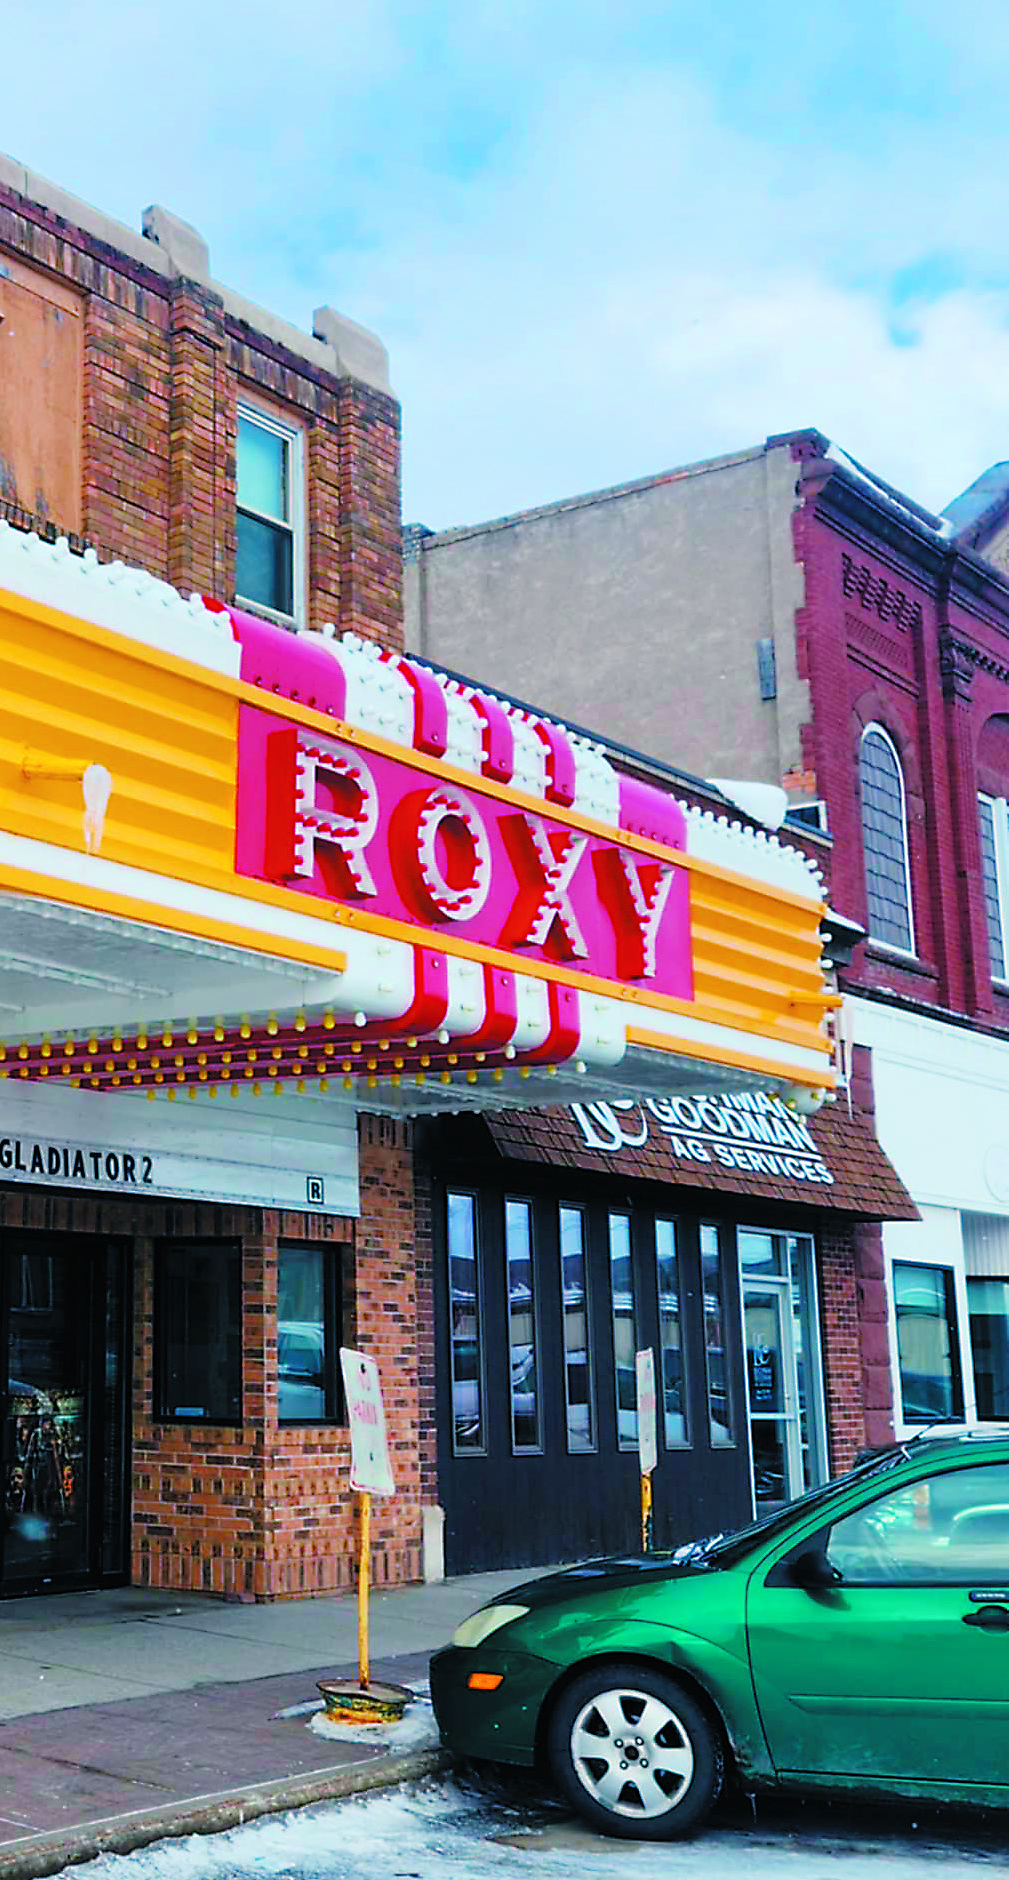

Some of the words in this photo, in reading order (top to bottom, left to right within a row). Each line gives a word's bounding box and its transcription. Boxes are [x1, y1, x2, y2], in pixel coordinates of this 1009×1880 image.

[267, 729, 675, 980] ROXY
[645, 1095, 819, 1152] GOODMAN
[670, 1135, 712, 1163] AG
[714, 1142, 835, 1185] SERVICES
[309, 1180, 321, 1201] R
